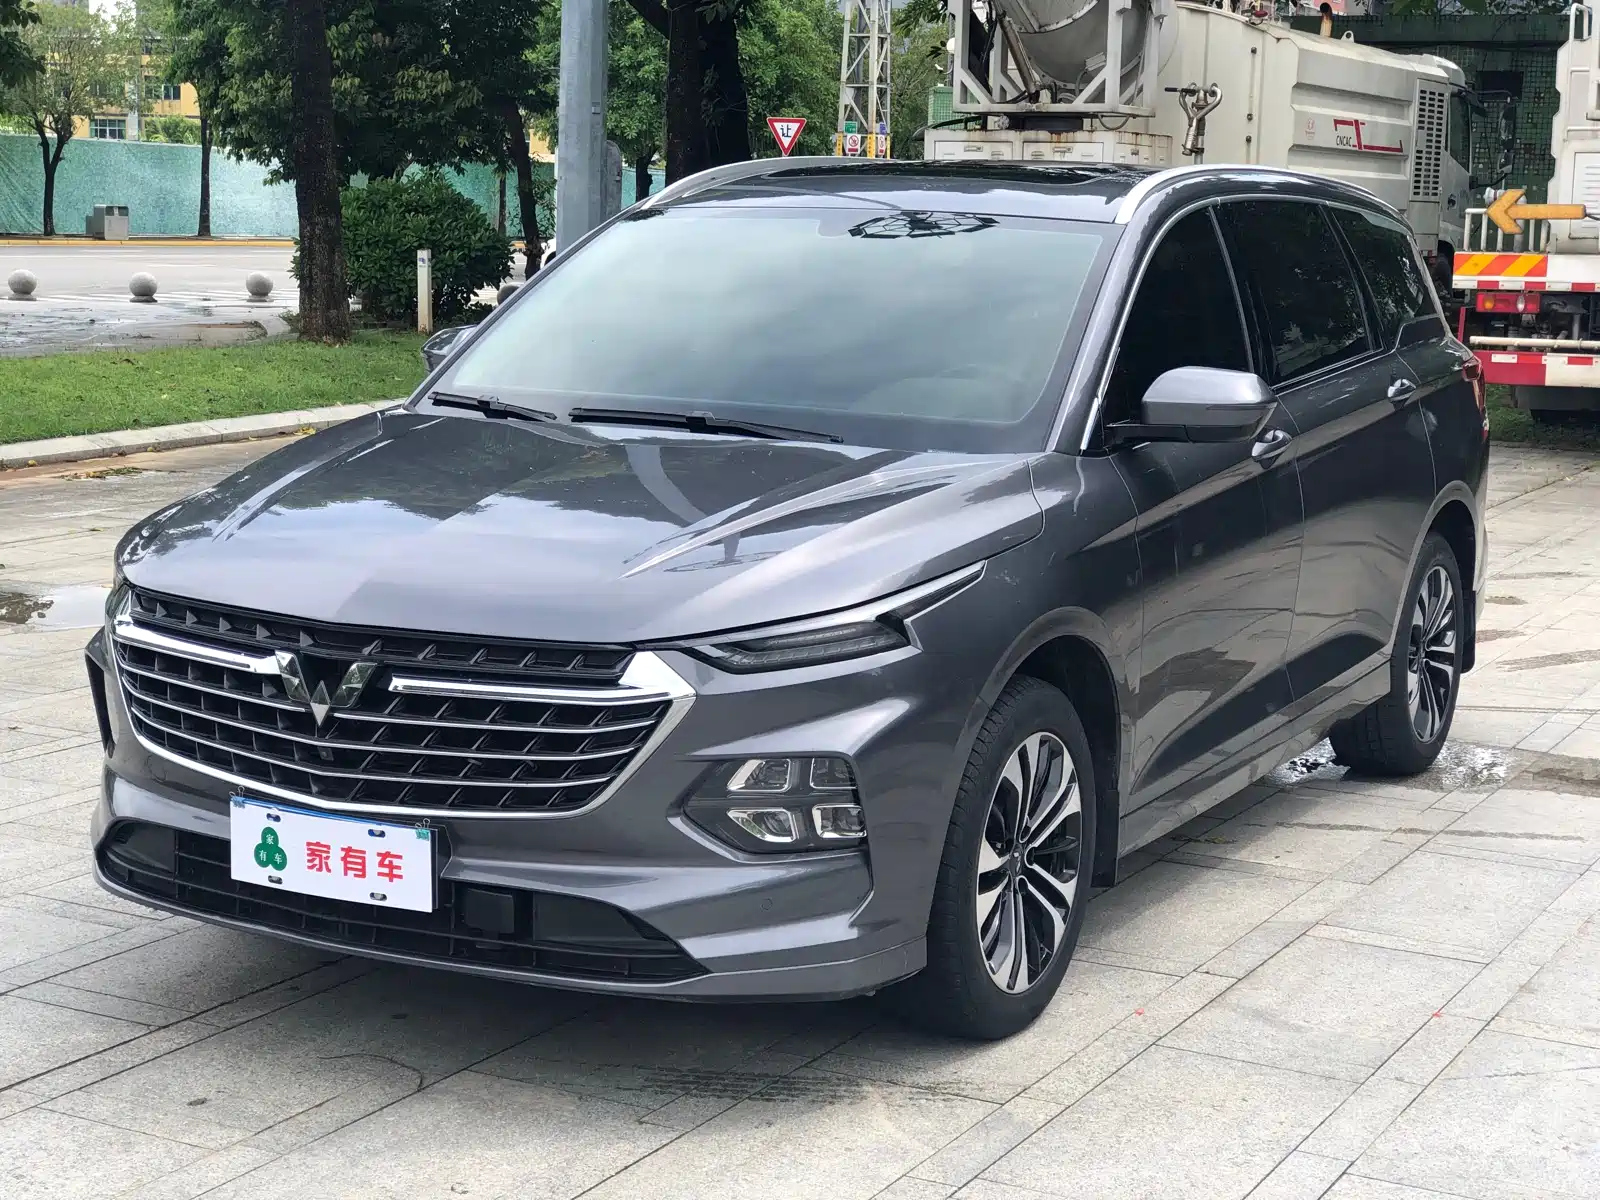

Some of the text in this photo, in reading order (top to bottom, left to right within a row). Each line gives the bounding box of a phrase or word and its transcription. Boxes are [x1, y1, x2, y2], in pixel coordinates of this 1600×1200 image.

[780, 124, 792, 138] 让
[265, 833, 275, 845] 家
[306, 841, 404, 883] 家有车
